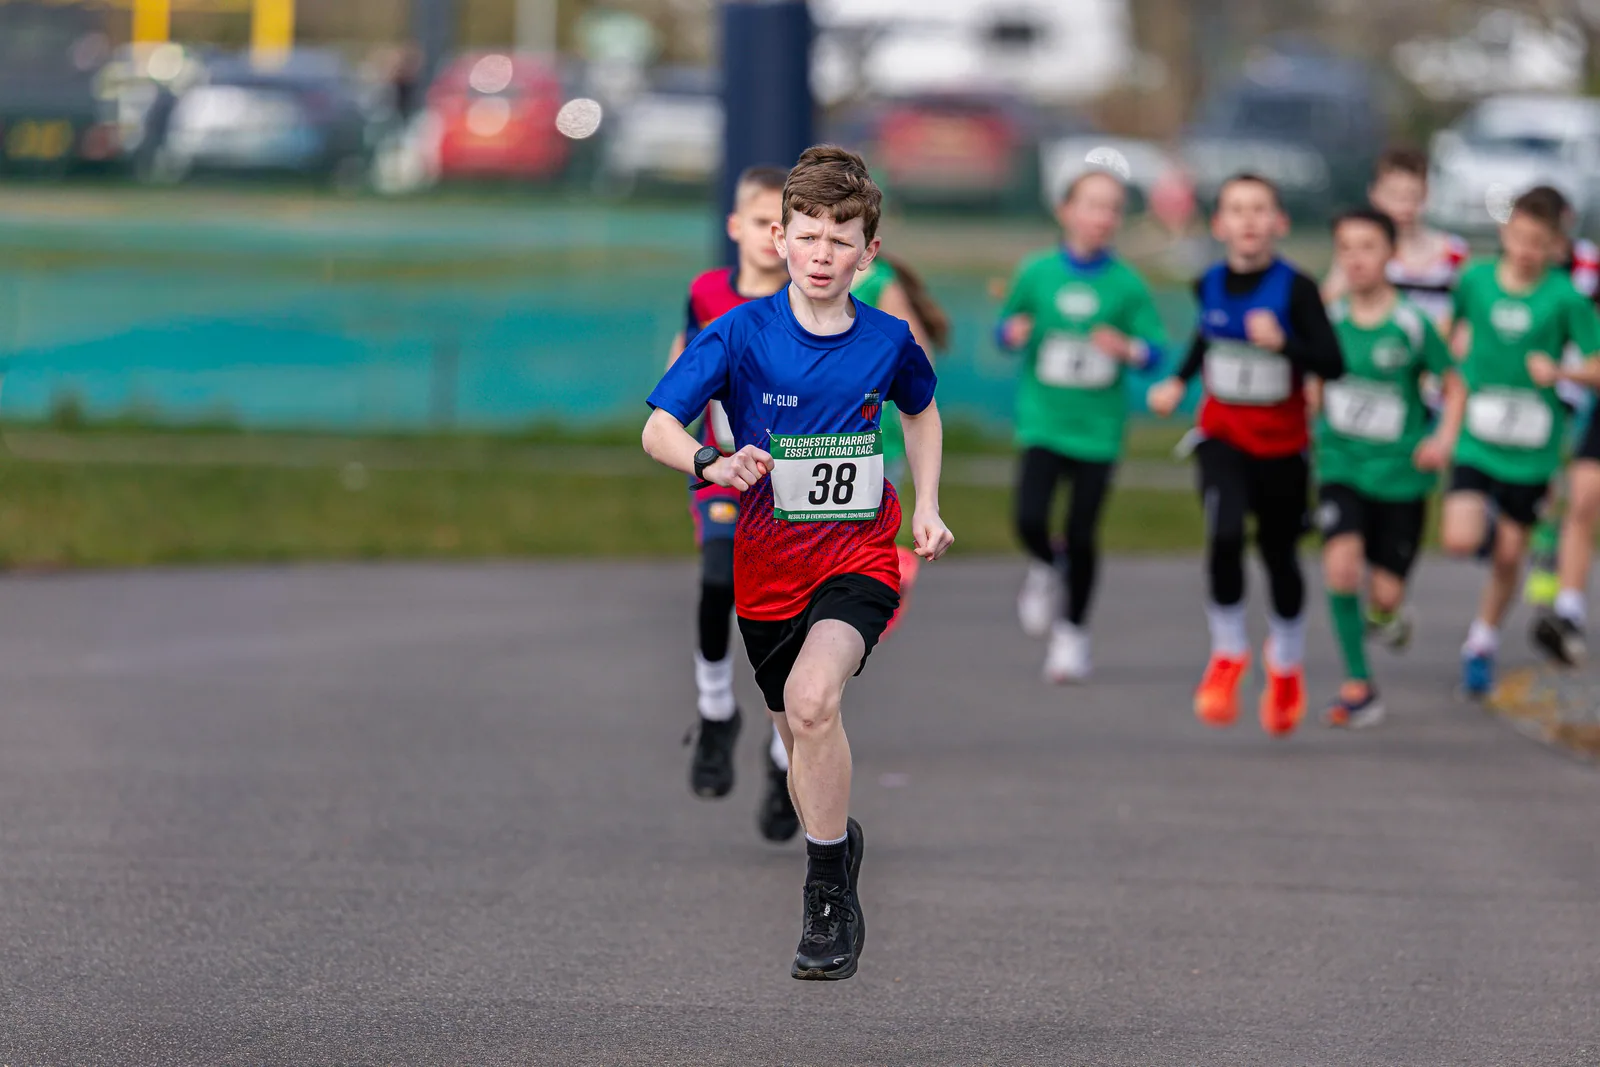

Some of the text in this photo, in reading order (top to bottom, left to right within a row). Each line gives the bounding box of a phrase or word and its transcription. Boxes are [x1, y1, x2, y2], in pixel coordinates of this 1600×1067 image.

[780, 433, 876, 448] COLCHESTER HARRIERS
[784, 447, 813, 458] ESSEX
[828, 446, 854, 457] ROAD
[855, 444, 874, 455] RACE
[808, 462, 857, 505] 38
